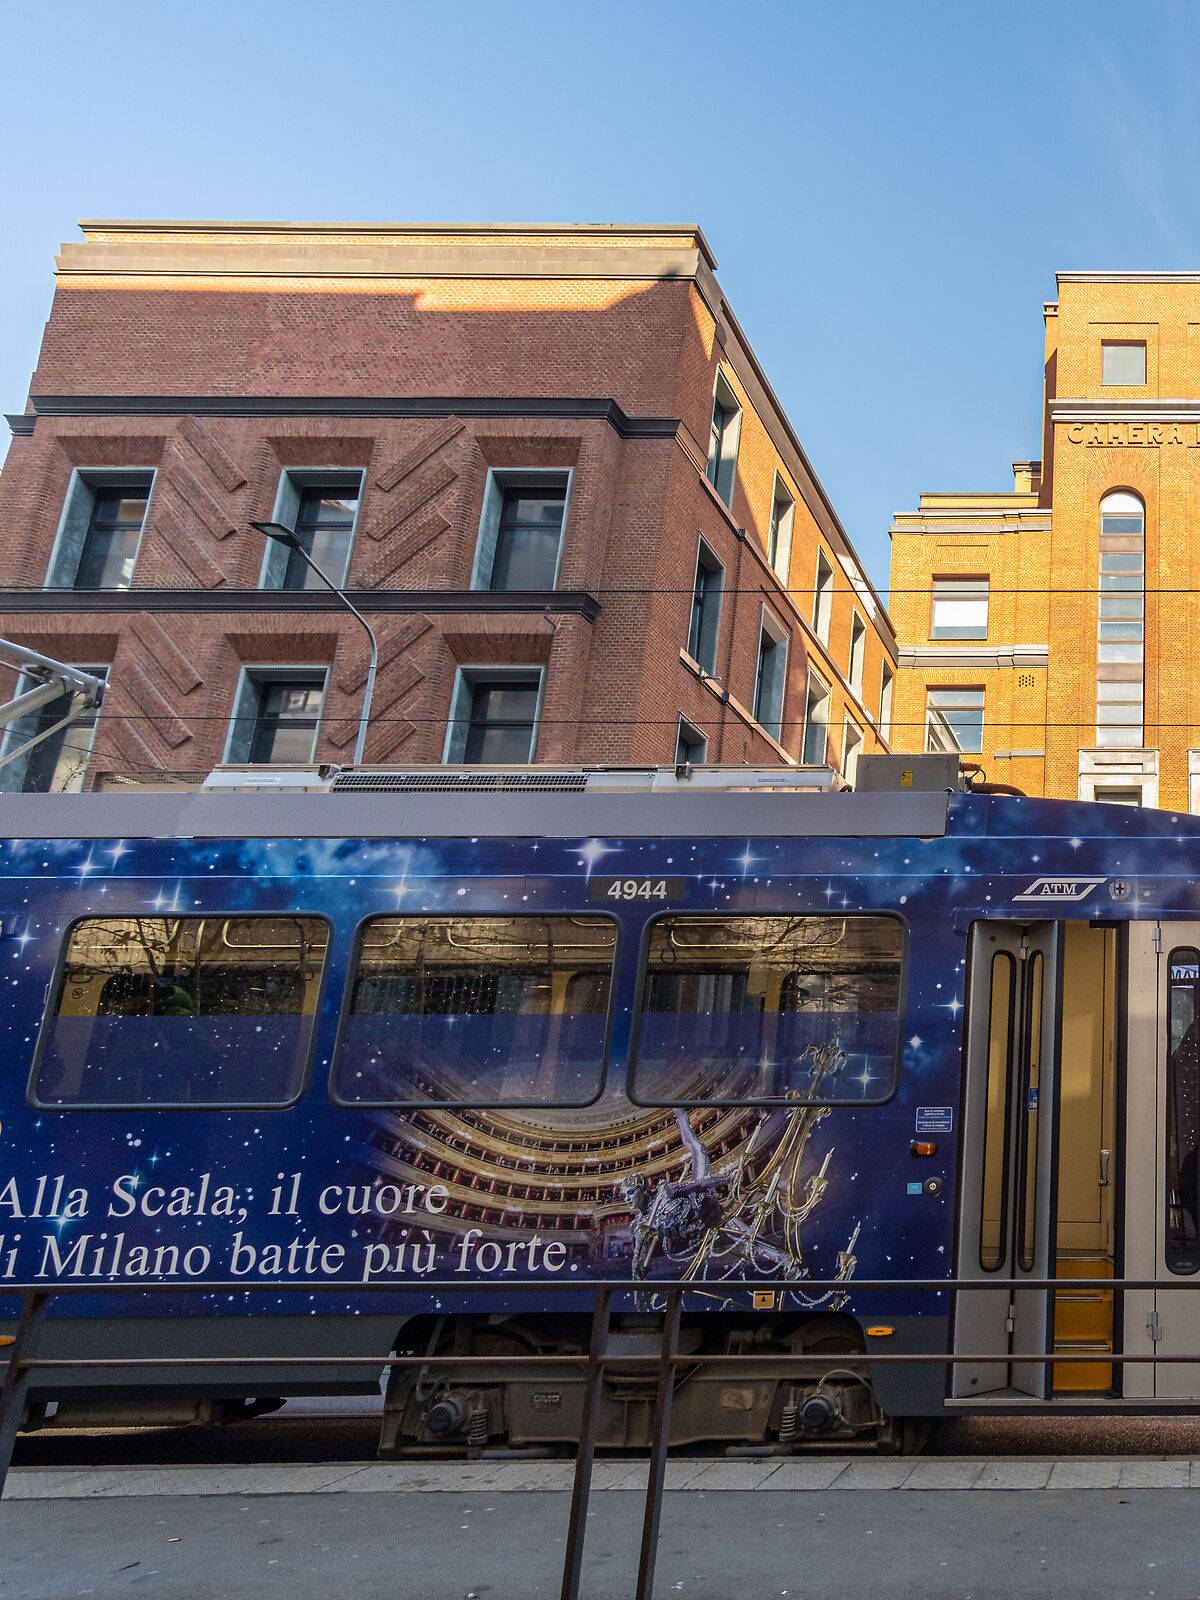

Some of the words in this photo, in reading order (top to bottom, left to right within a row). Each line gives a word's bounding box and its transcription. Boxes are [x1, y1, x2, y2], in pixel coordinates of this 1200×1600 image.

[1067, 423, 1183, 444] CAMERA
[607, 880, 667, 900] 4944
[1040, 883, 1077, 895] ATM
[0, 1175, 89, 1218] Alla
[107, 1173, 248, 1225] Scala,
[267, 1172, 302, 1215] il
[319, 1184, 449, 1214] cuore
[0, 1233, 22, 1278] i
[34, 1232, 210, 1278] Milano
[230, 1230, 345, 1275] batte
[363, 1229, 437, 1282] più
[454, 1228, 578, 1272] forte.
